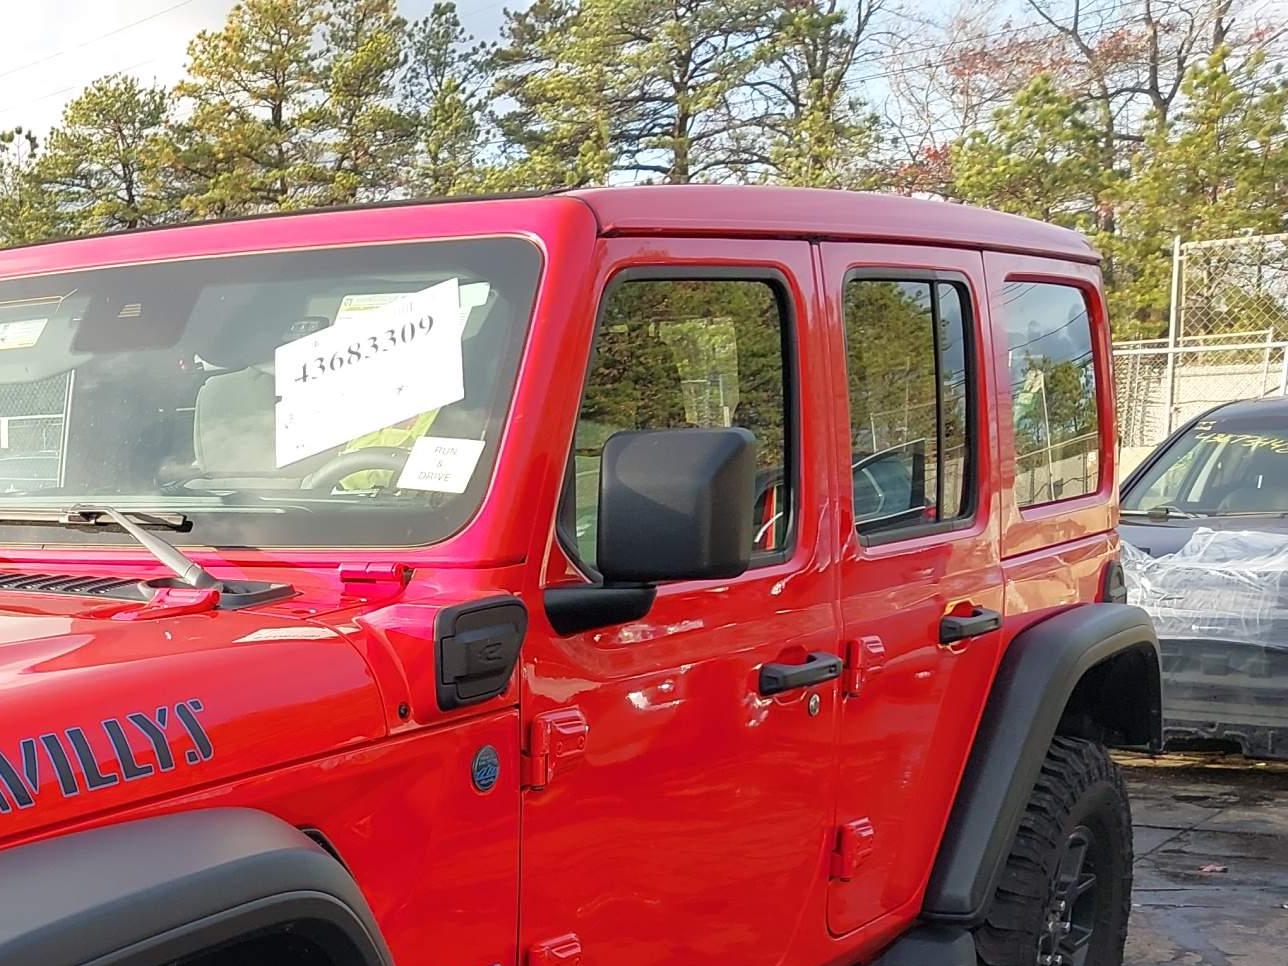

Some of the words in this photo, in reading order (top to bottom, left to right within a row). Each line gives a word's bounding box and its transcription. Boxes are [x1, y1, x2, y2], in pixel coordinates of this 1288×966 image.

[294, 315, 434, 383] 43683309
[434, 445, 458, 456] RUN
[416, 471, 453, 482] DRIVE
